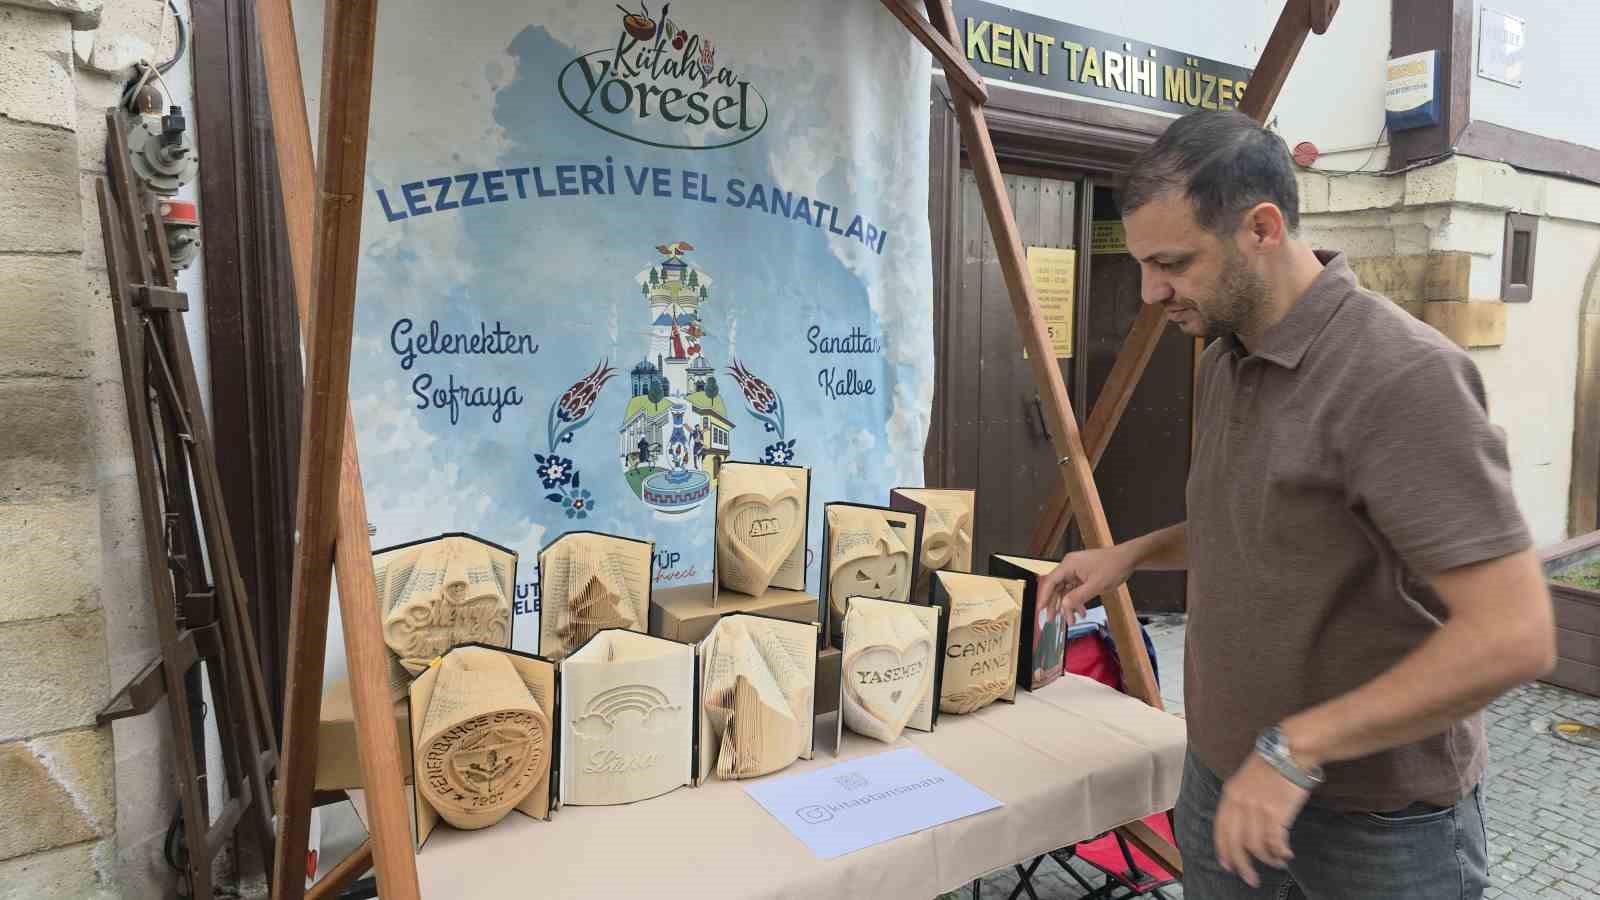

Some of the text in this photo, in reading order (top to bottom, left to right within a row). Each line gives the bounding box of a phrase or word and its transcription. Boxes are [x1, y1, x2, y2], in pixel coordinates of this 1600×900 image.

[575, 56, 757, 132] Yöresel
[966, 17, 1247, 111] KENT TARİHİ MÜZES
[375, 155, 888, 255] LEZZETLERİ VE EL SANATLARI
[390, 317, 540, 370] Gelenekten
[411, 373, 524, 425] Sofraya
[818, 366, 877, 401] Kalbe
